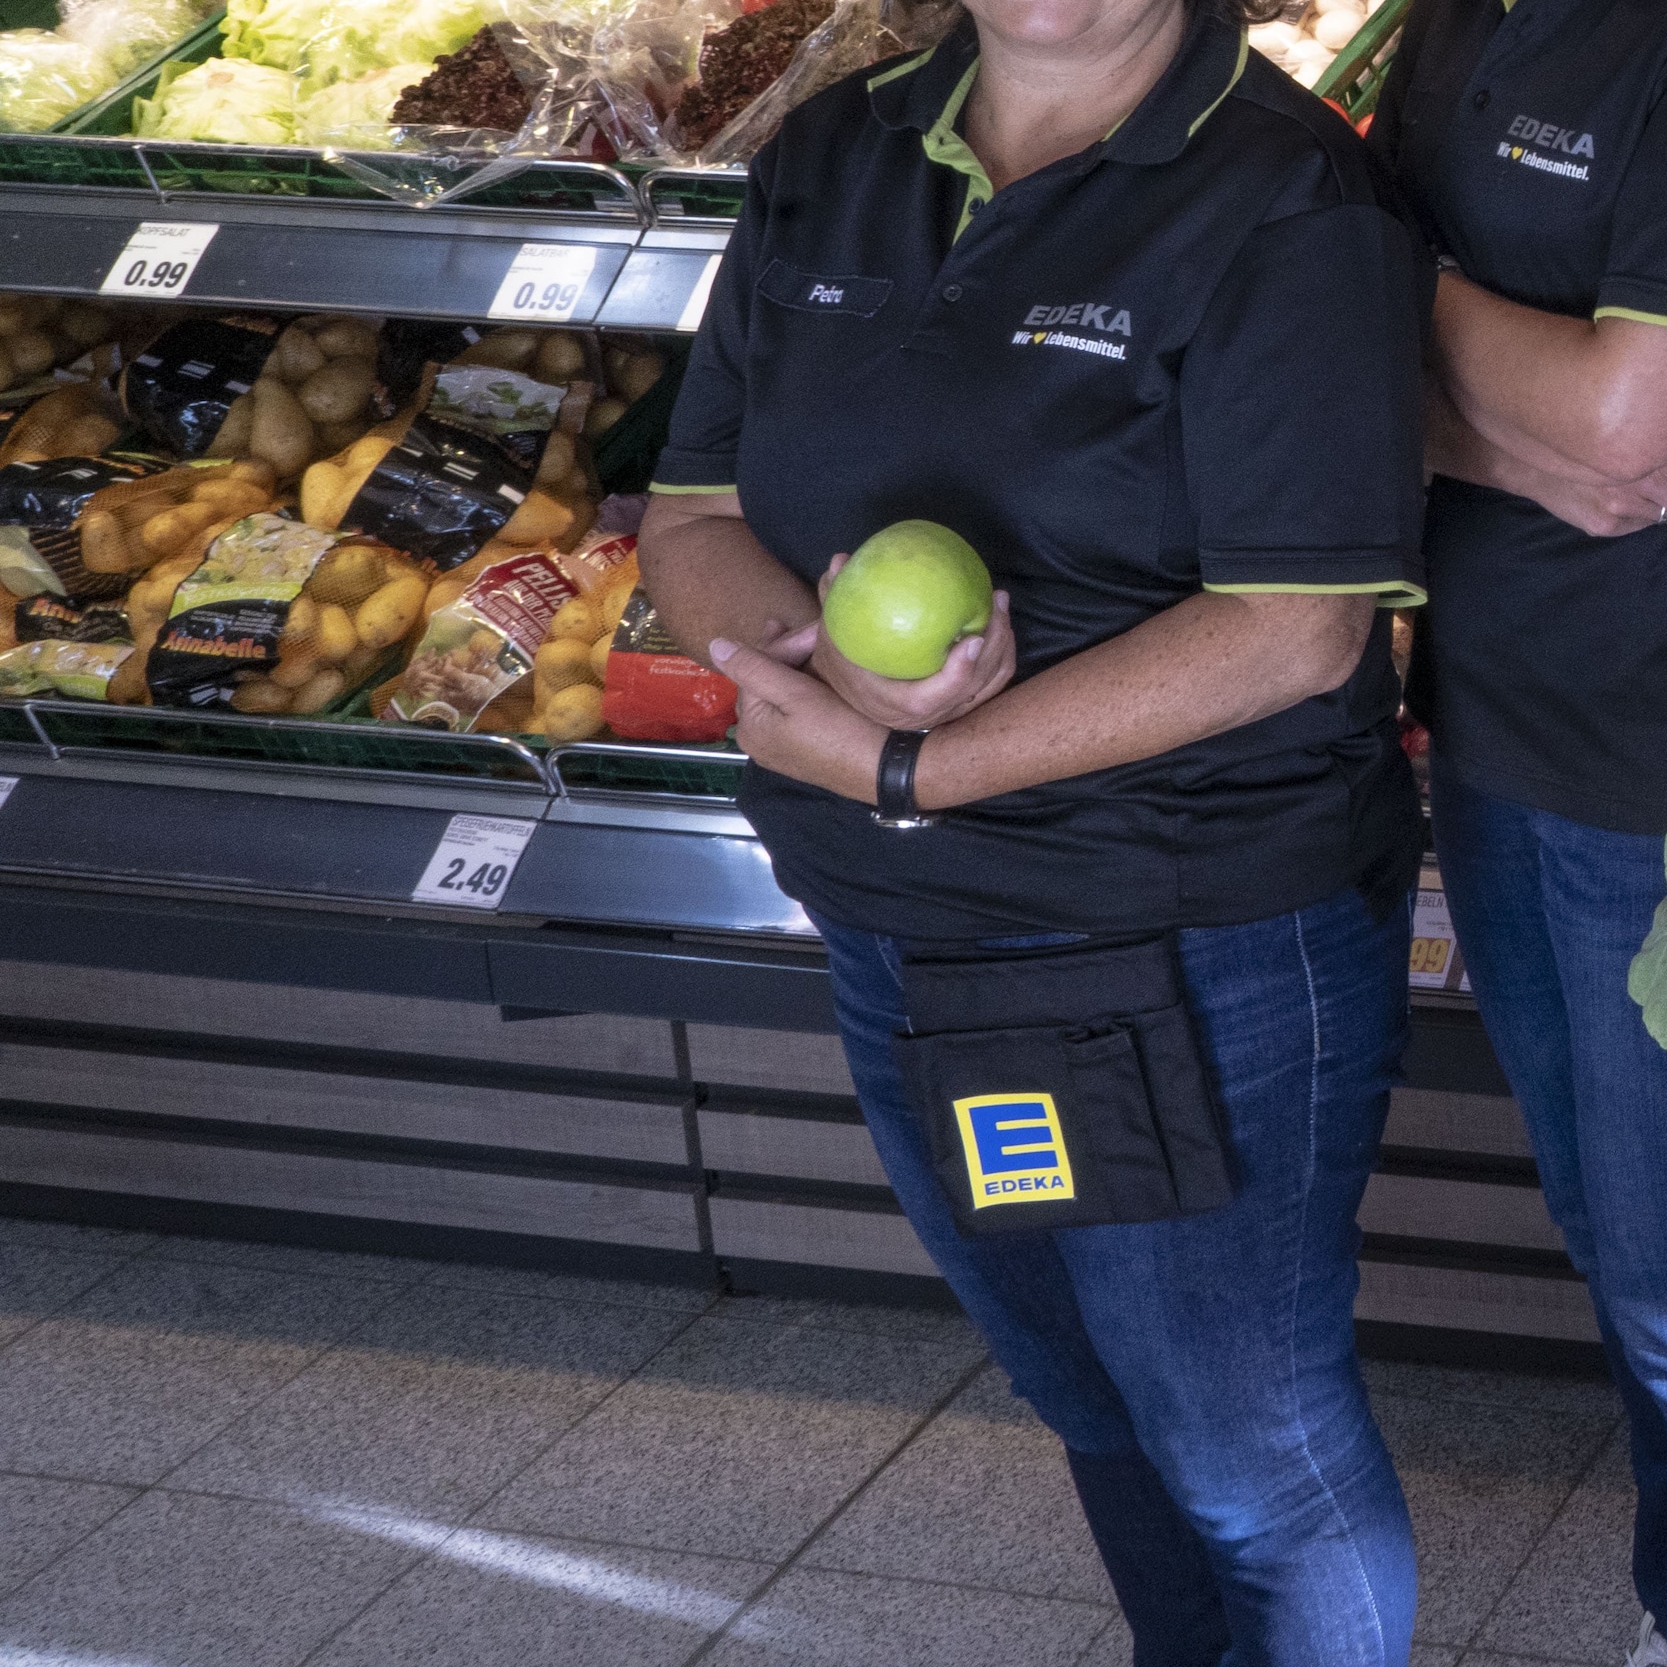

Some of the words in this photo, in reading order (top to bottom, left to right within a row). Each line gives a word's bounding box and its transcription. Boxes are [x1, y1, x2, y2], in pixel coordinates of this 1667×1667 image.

[1507, 115, 1595, 159] EDEKA
[1497, 141, 1512, 158] Wir
[1520, 149, 1590, 181] Lebensmittel.
[139, 227, 191, 237] KOPFSALAT
[124, 260, 188, 288] 0.99
[513, 282, 578, 311] 0.99
[1023, 303, 1132, 337] EDEKA
[1011, 330, 1033, 344] Wir
[1043, 331, 1127, 360] Lebensmittel.
[160, 631, 266, 659] Annabelle
[437, 858, 508, 895] 2.49
[968, 1102, 1058, 1175] E
[985, 1175, 1064, 1195] EDEKA
